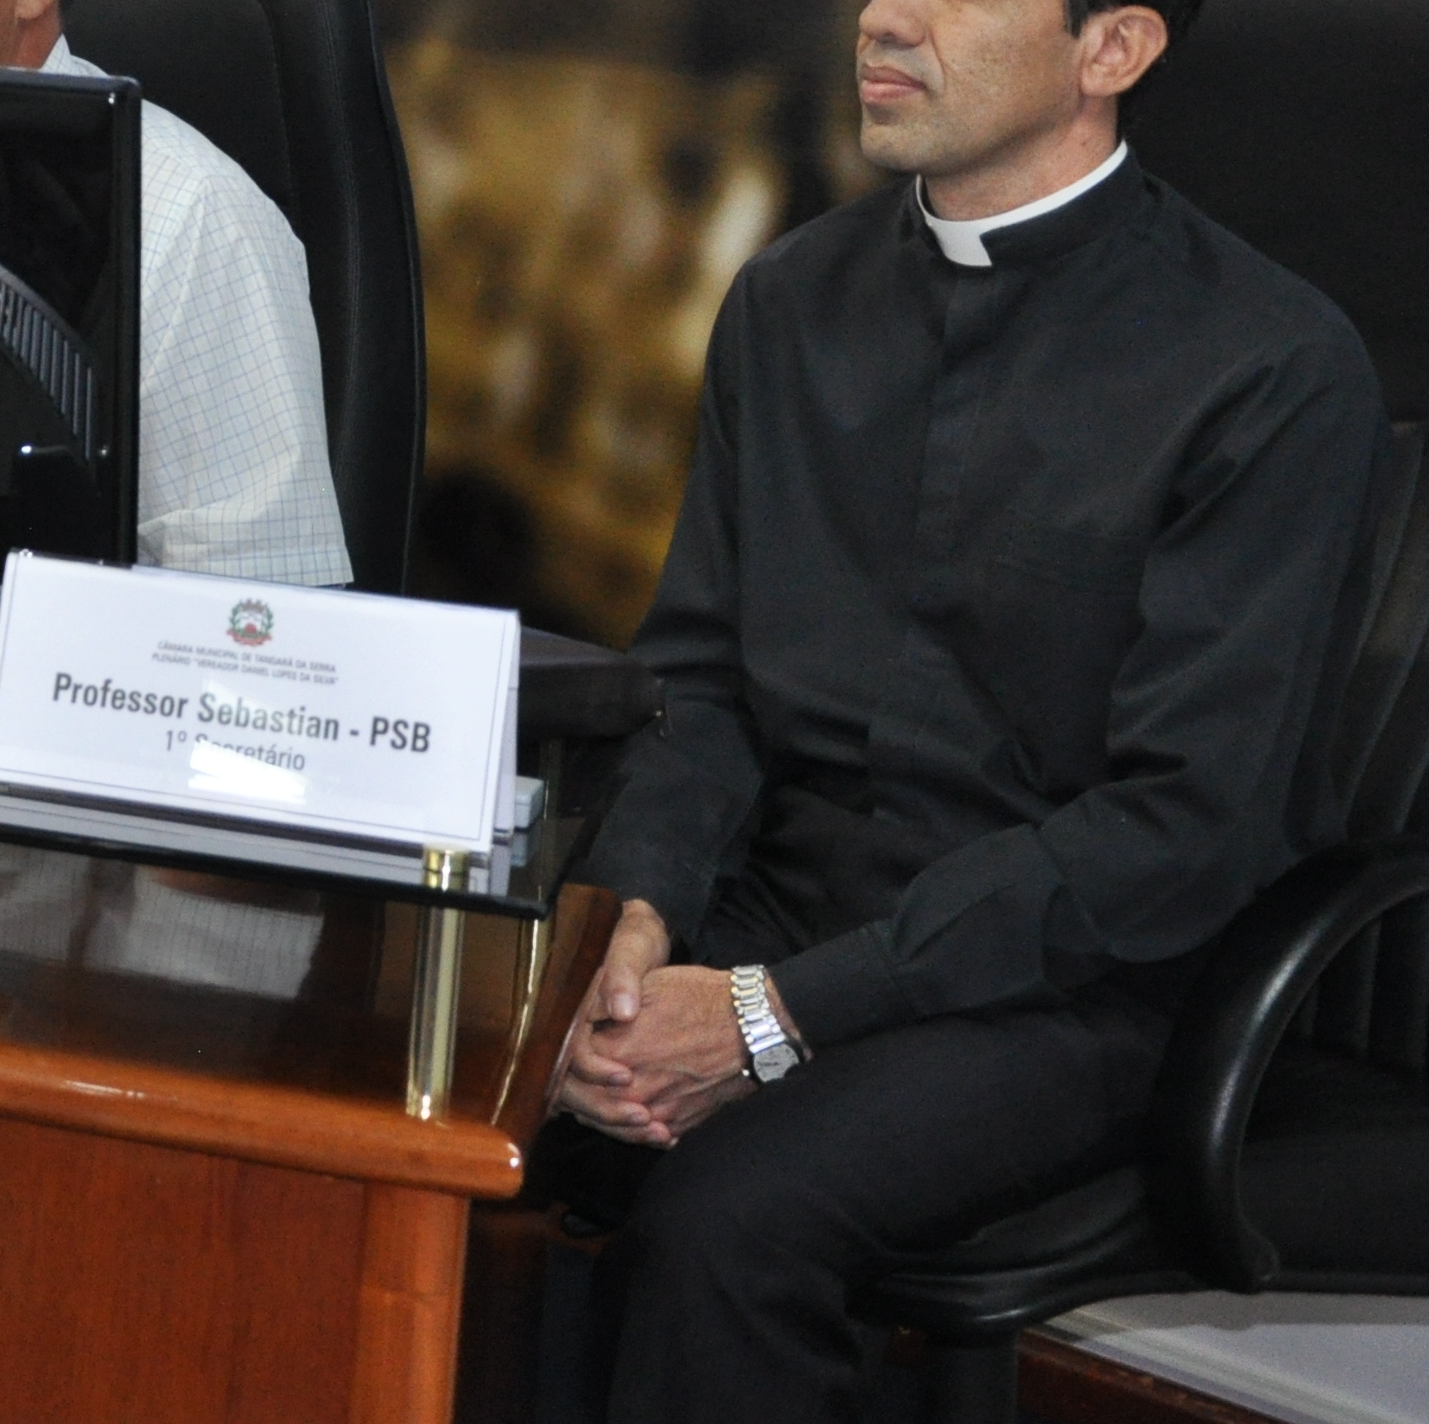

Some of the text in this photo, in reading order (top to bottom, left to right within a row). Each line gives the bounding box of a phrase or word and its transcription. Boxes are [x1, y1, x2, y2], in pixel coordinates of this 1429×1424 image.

[158, 640, 336, 673] CÂMARA MUNICIPAL DE TANGARÁ DA SERRA
[272, 669, 297, 680] LOPES
[299, 673, 310, 682] DA
[52, 672, 189, 721] Professor
[197, 692, 340, 741] Sebastian
[369, 716, 431, 753] PSB
[166, 730, 305, 771] 1º retário
